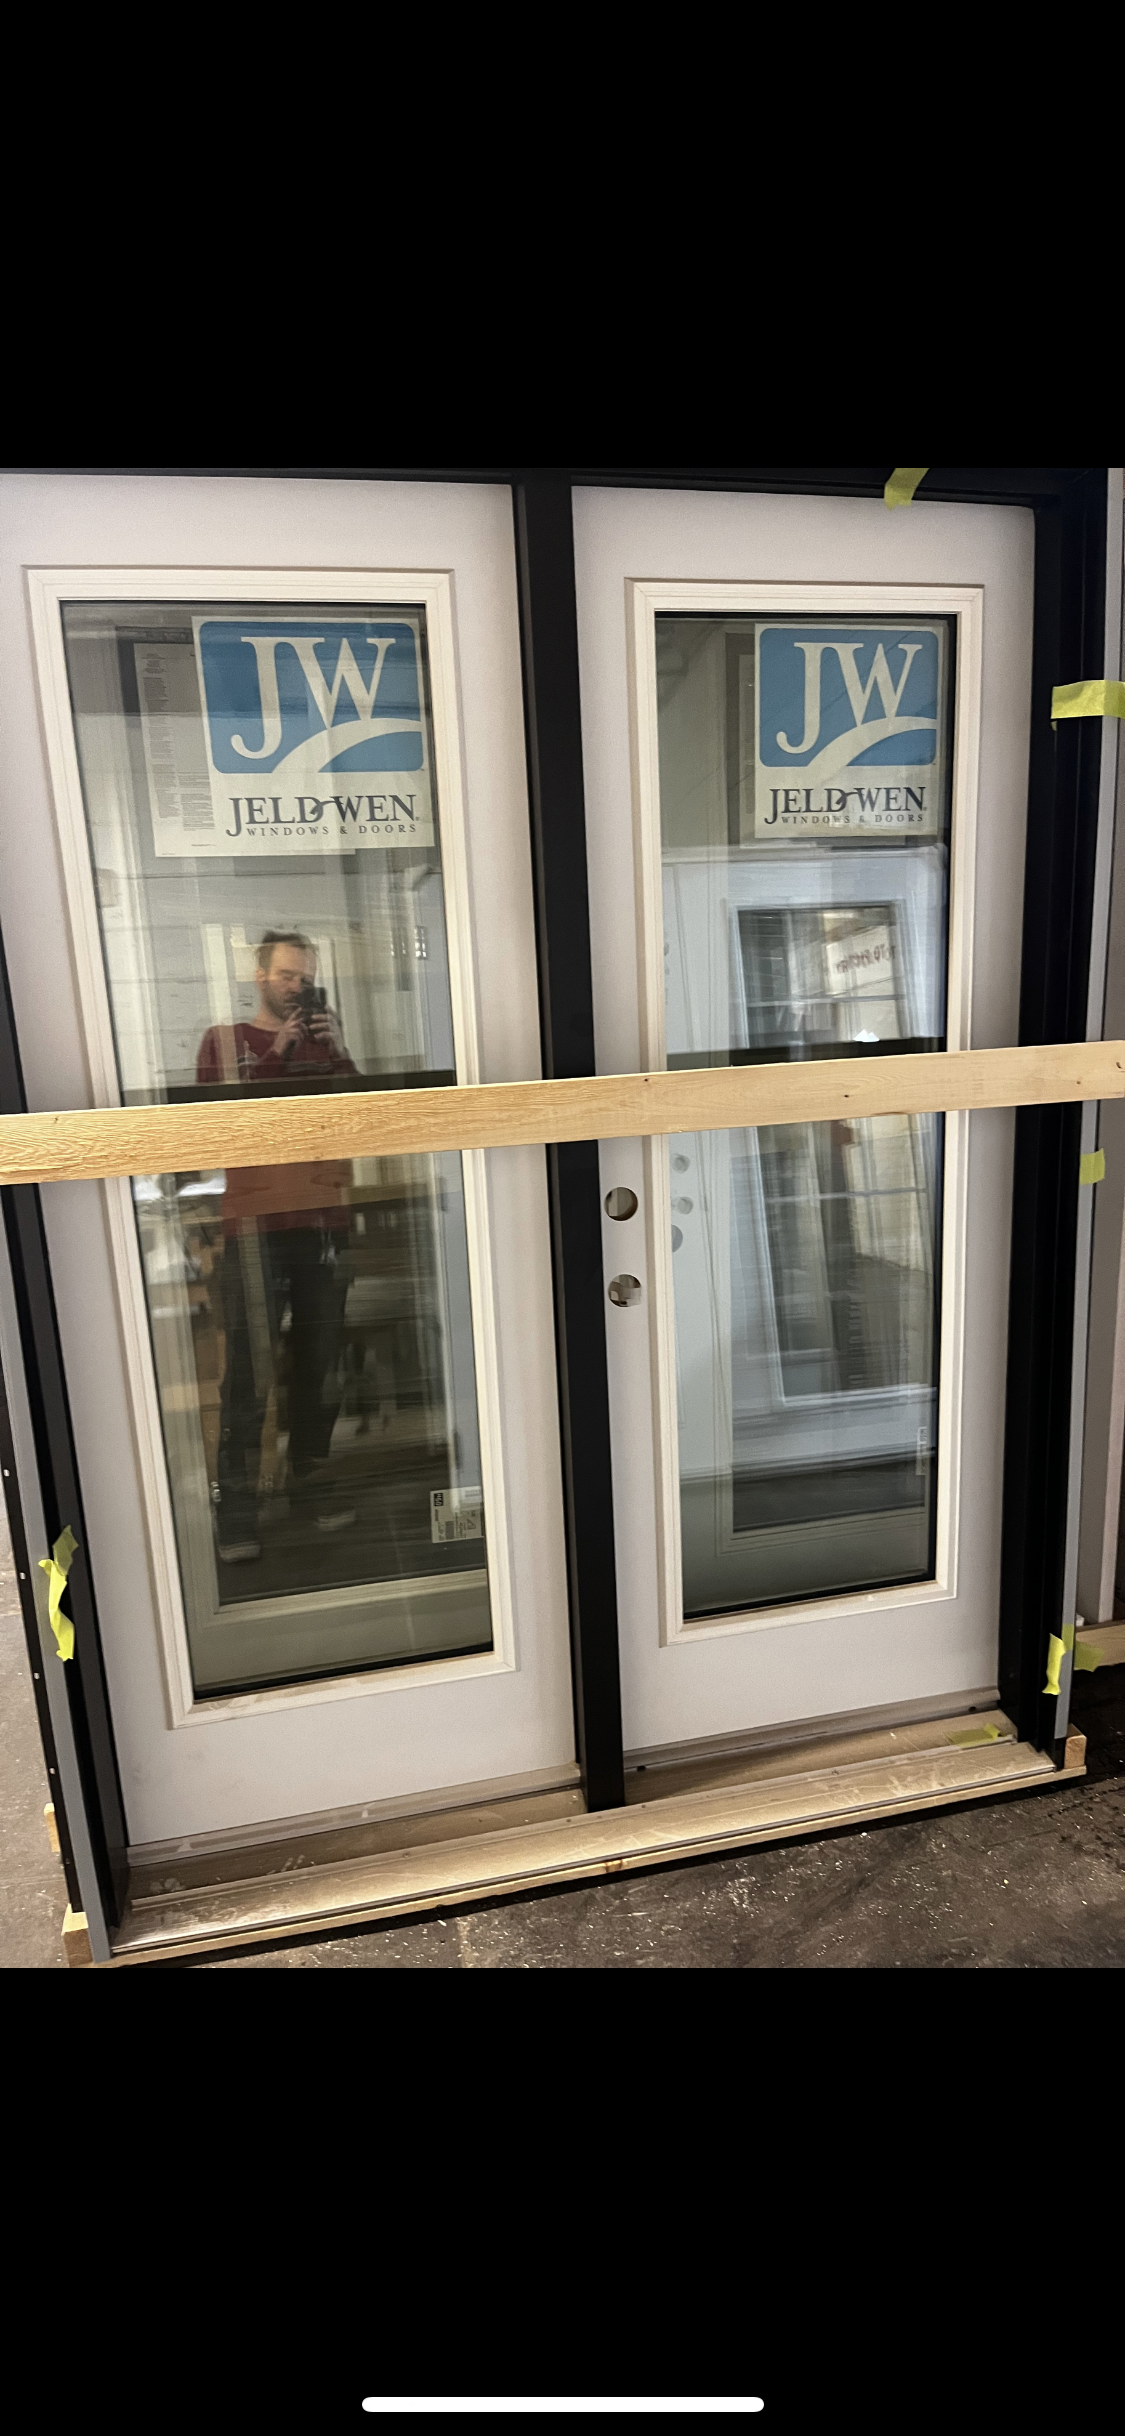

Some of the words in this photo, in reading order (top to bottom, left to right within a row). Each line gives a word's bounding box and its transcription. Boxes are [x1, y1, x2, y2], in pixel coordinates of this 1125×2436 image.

[230, 636, 396, 759] JW
[776, 642, 923, 754] JW
[246, 825, 330, 837] WINDOWS
[339, 825, 349, 835] &
[358, 823, 417, 835] DOORS
[781, 815, 851, 825] WINDOWS
[858, 815, 866, 824] &
[874, 813, 924, 824] DOORS
